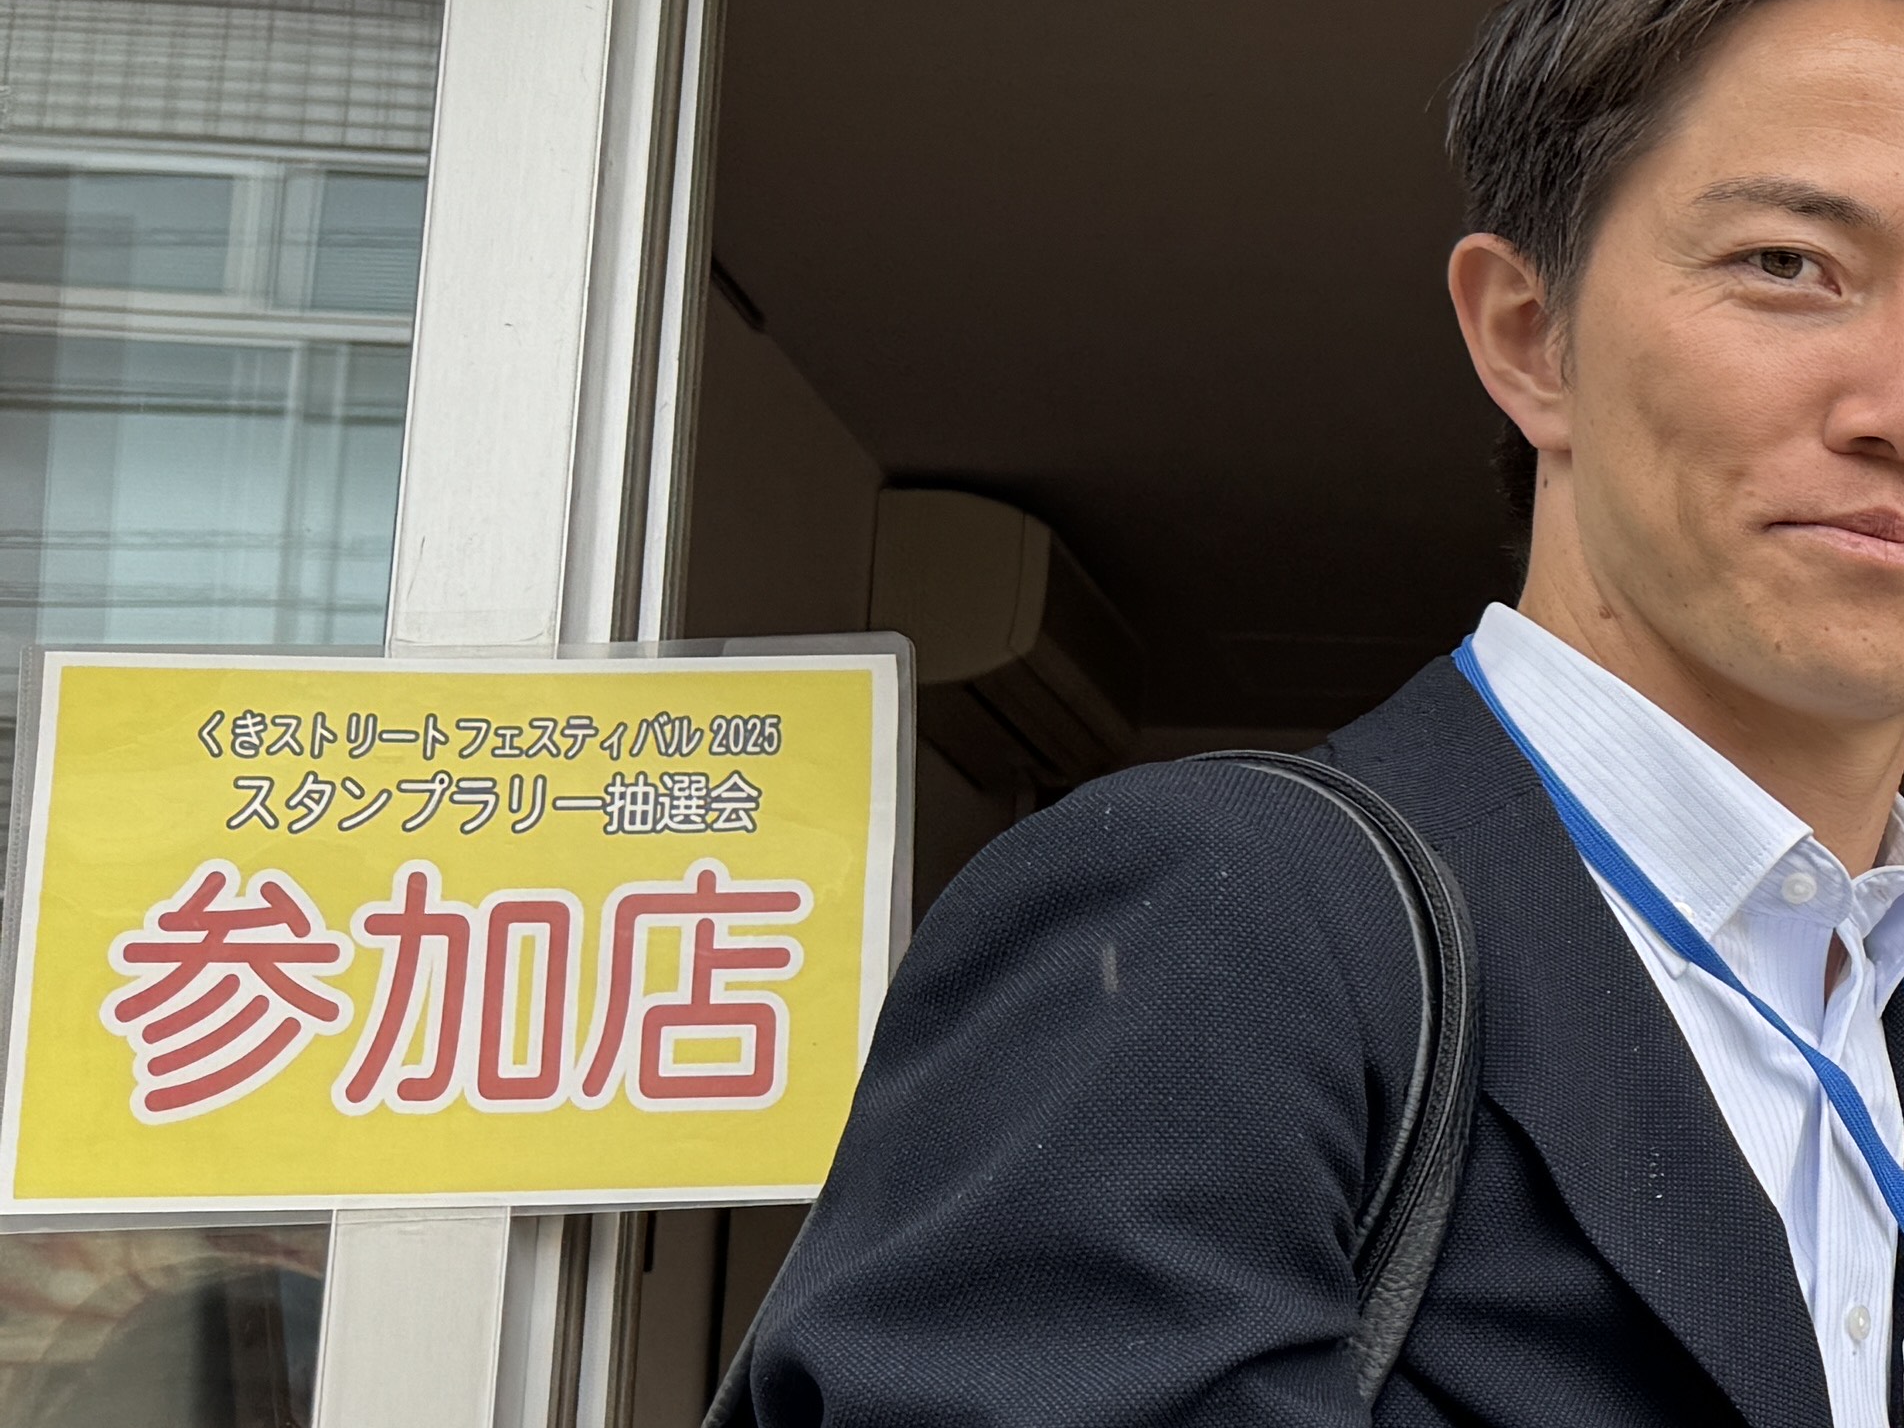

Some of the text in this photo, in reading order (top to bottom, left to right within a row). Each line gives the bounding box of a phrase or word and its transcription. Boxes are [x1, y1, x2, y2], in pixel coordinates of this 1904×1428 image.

[198, 709, 782, 761] くきストリートフェスティバル 2025
[226, 770, 762, 837] スタンプラリー抽選会
[110, 864, 806, 1118] 参加店
